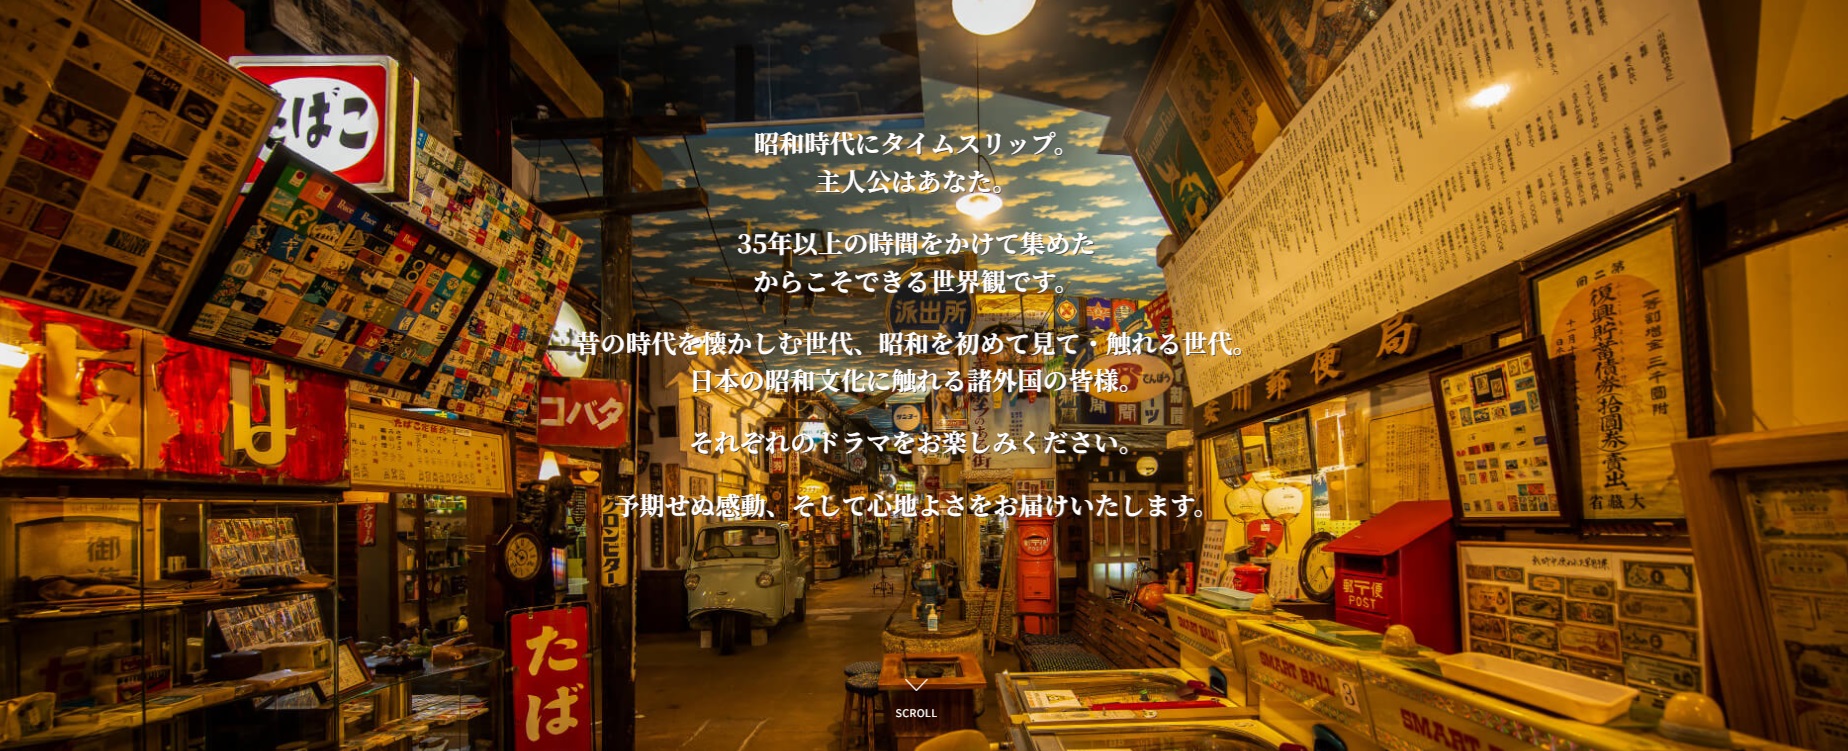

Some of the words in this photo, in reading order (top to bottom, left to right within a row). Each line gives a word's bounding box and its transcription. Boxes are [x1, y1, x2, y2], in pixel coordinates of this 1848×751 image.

[894, 300, 967, 325] 派出所
[1348, 594, 1376, 610] POST
[1199, 625, 1218, 644] BALL
[525, 625, 585, 742] たば
[1259, 651, 1298, 679] SMART
[1299, 667, 1335, 697] BALL
[1341, 682, 1356, 707] 3
[1400, 708, 1481, 751] SMART
